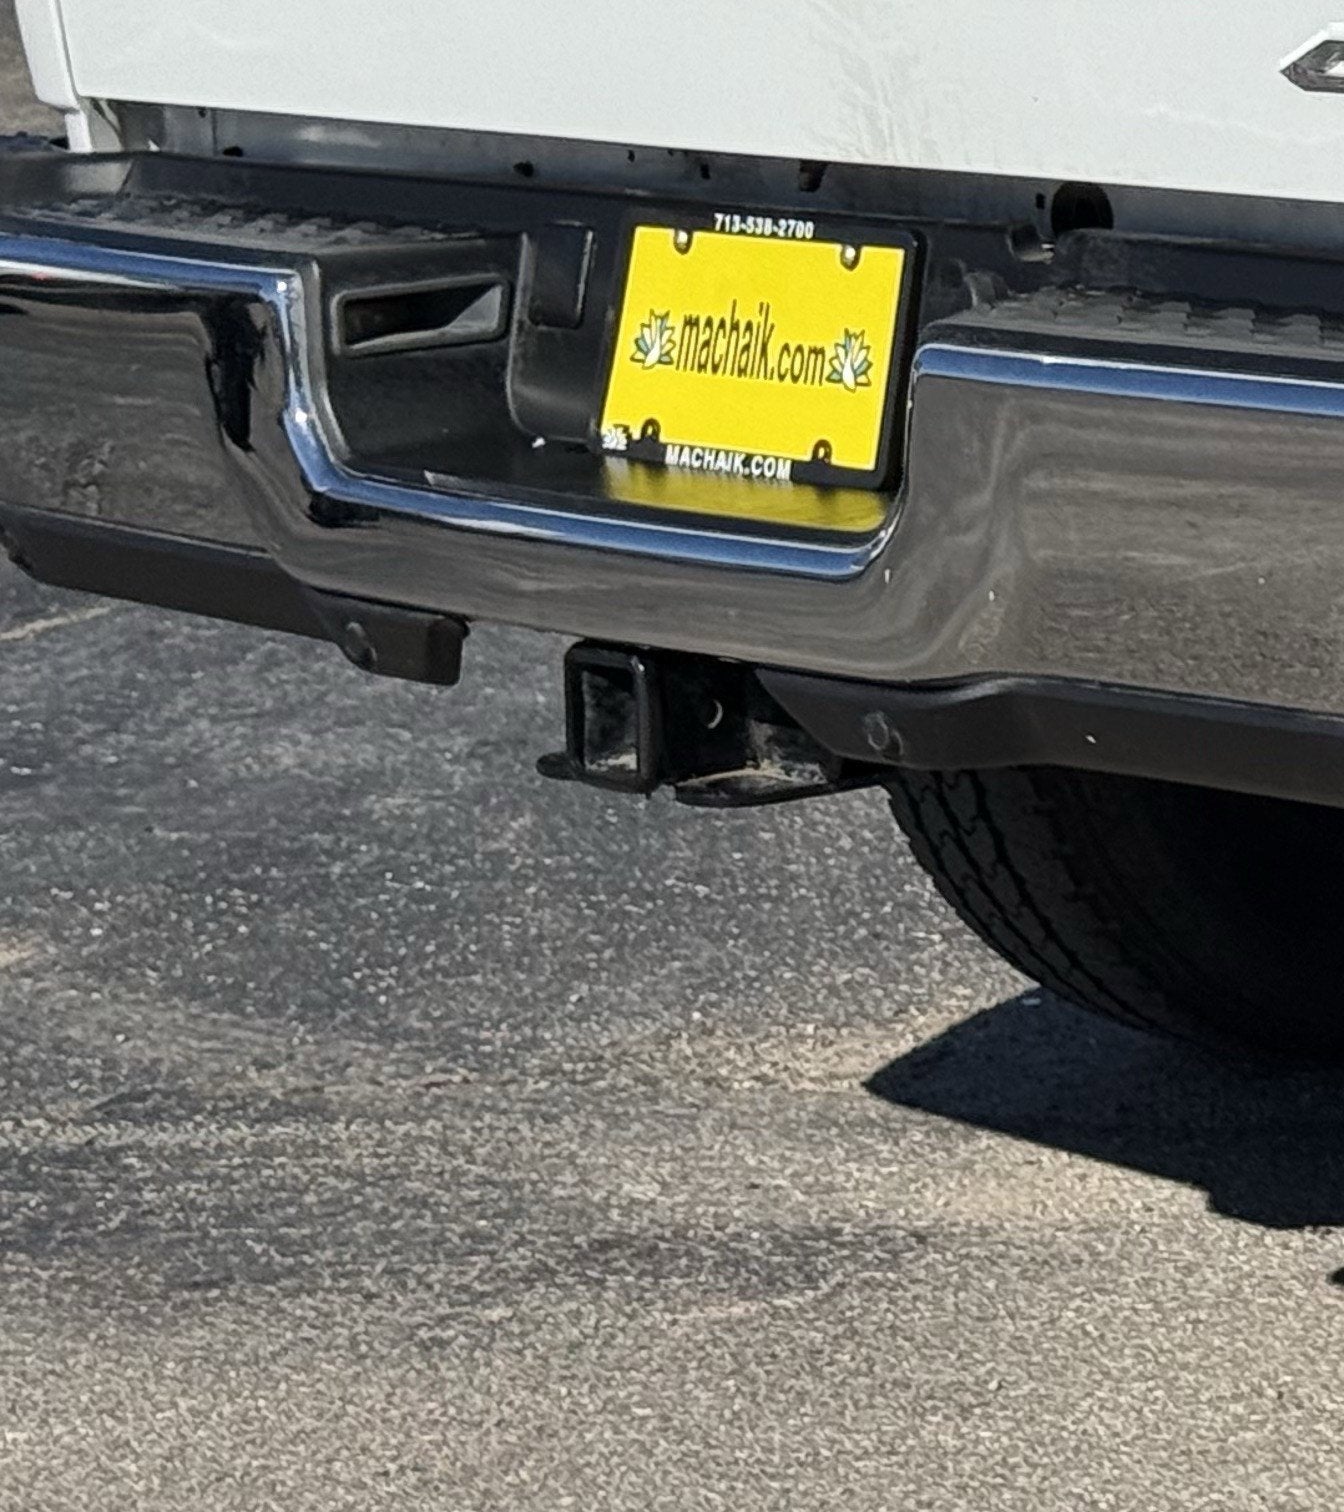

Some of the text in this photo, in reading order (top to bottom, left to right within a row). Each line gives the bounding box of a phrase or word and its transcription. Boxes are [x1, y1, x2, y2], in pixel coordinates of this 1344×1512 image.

[713, 212, 815, 240] 713-538-2700
[674, 298, 827, 387] machaik.com
[664, 444, 793, 482] MACHAIK.COM
